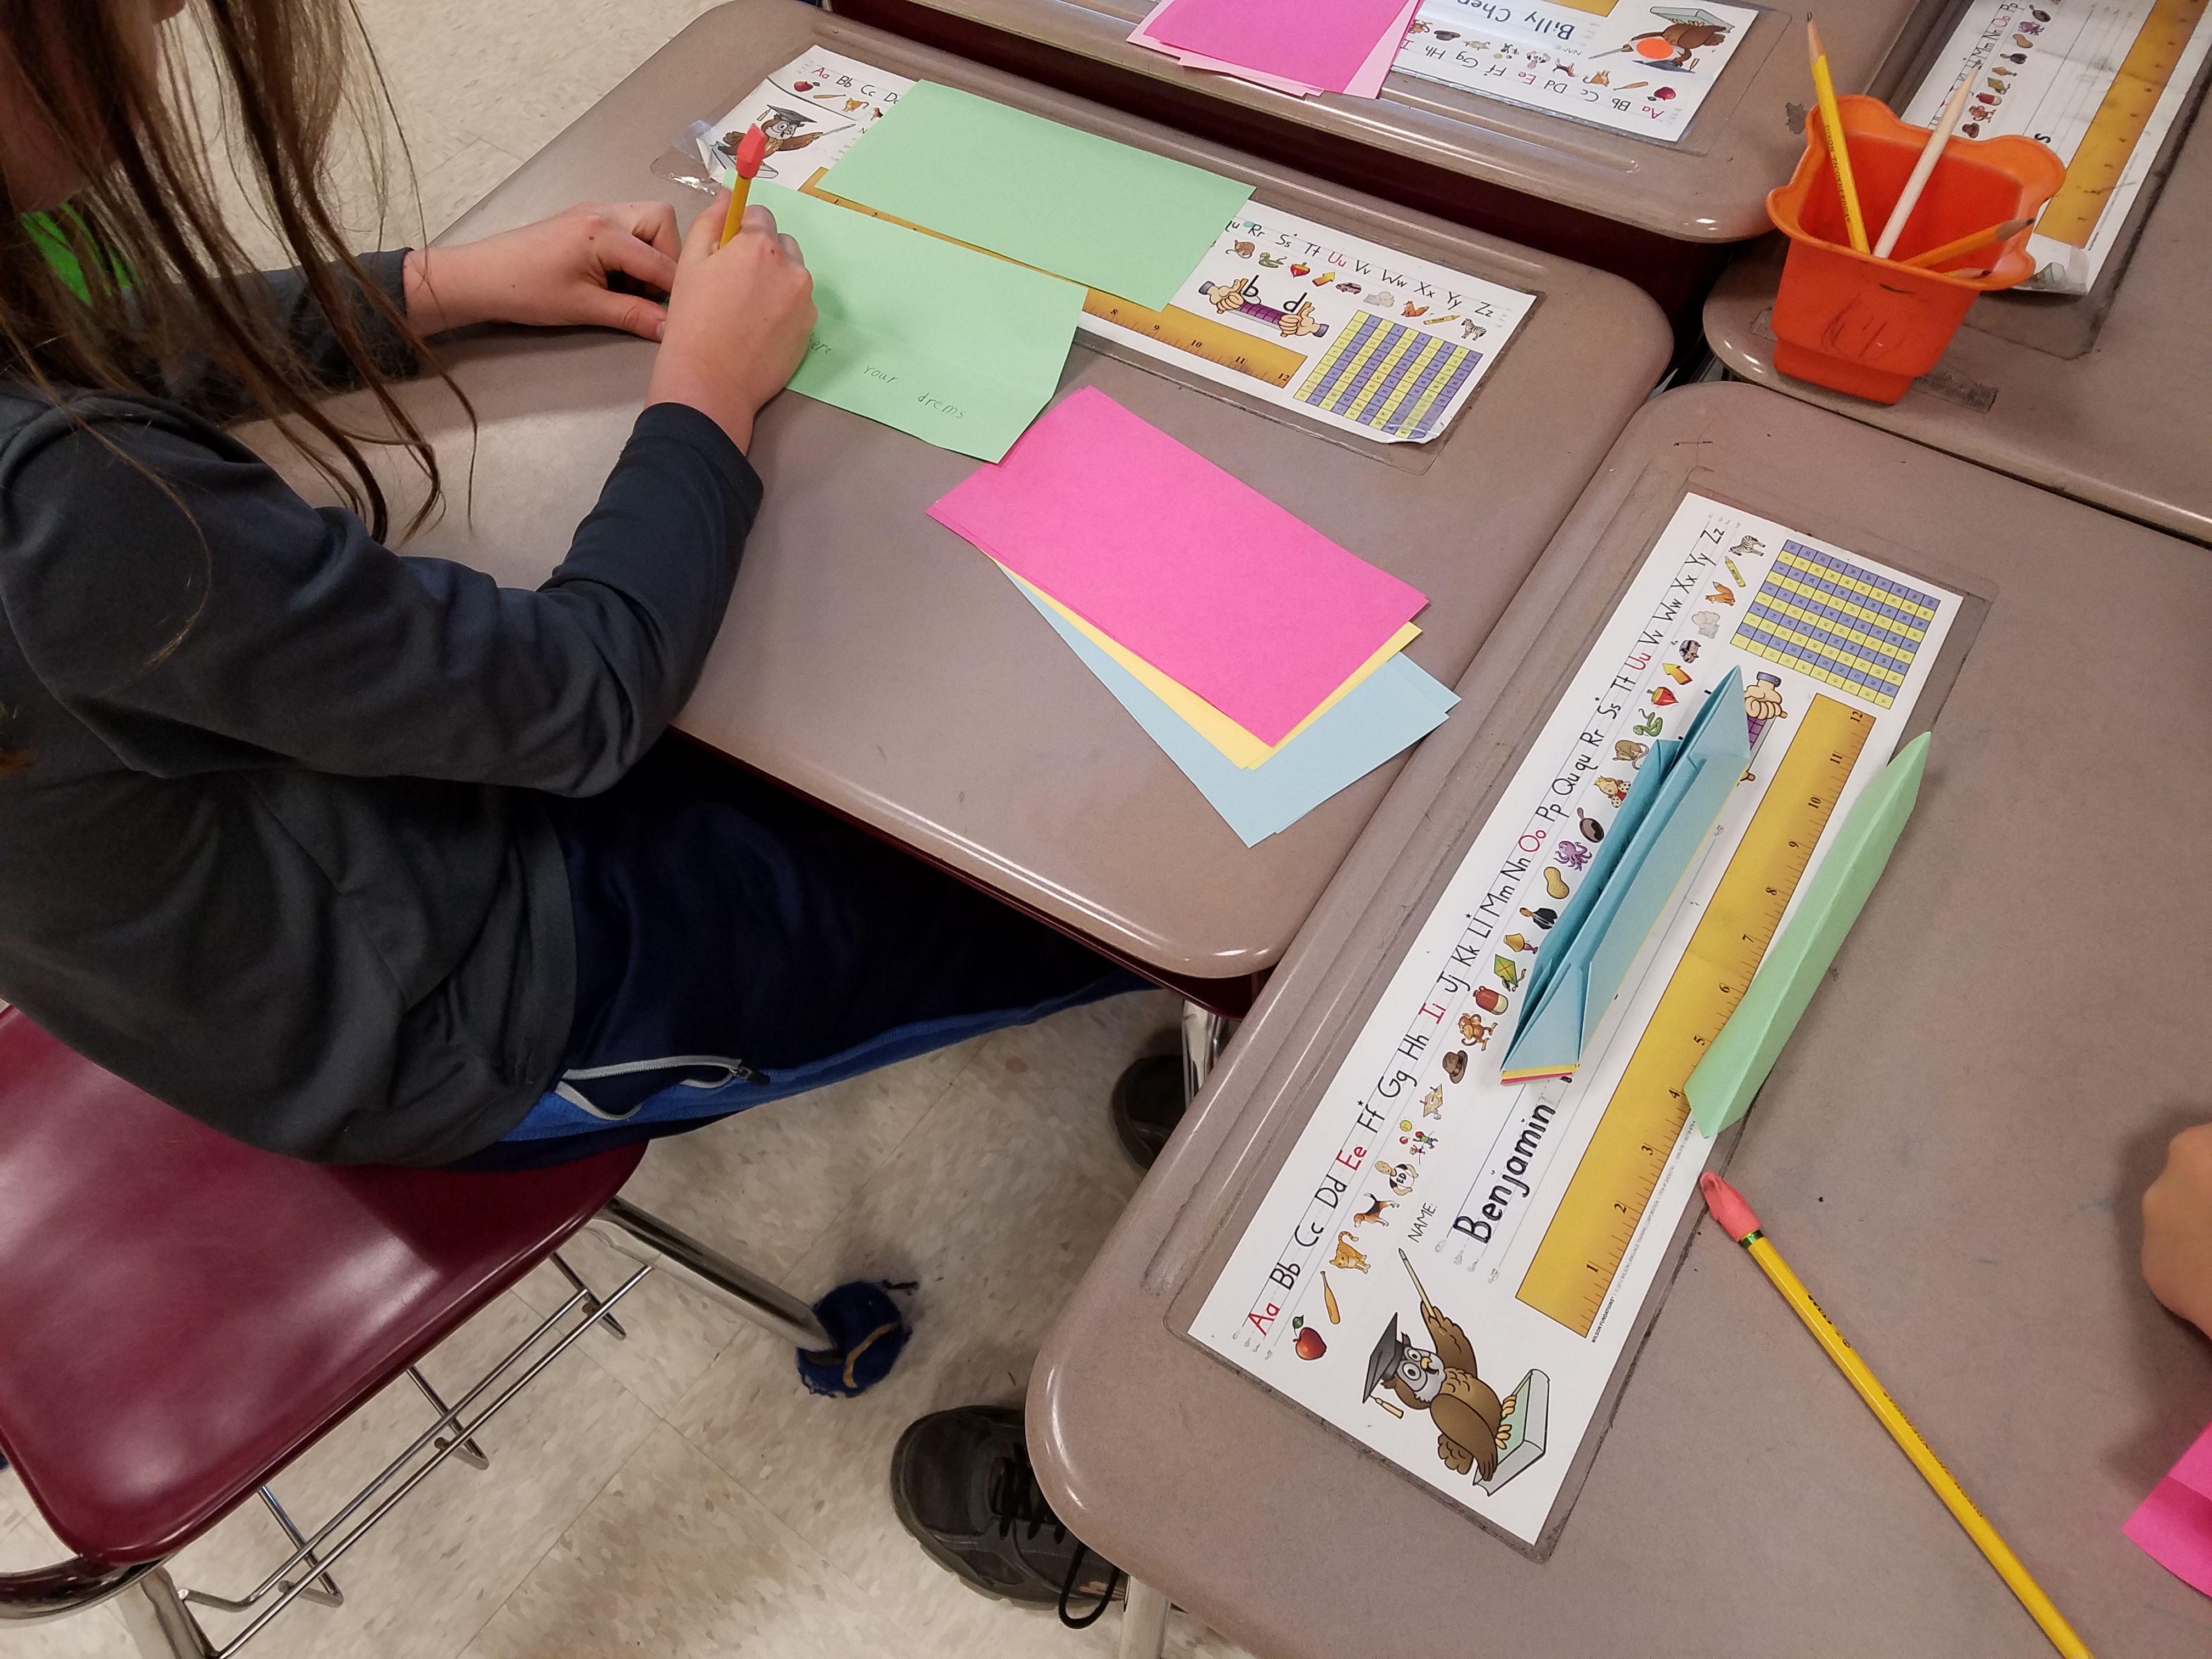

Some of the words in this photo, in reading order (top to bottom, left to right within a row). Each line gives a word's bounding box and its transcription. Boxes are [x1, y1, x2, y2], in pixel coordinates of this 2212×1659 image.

[1524, 11, 1576, 41] Billy
[1425, 46, 1447, 60] Hh
[1455, 50, 1479, 68] Gg
[811, 67, 830, 79] Aa
[836, 75, 852, 88] Bb
[861, 84, 876, 97] Cc
[1487, 64, 1507, 77] Ff
[1518, 71, 1537, 85] Ee
[1543, 80, 1568, 94] Dd
[1580, 88, 1600, 102] Cc
[1612, 98, 1631, 112] Bb
[1642, 105, 1665, 120] Aa
[1248, 223, 1265, 238] Rr
[1275, 234, 1292, 247] Ss
[1304, 242, 1321, 257] Tt
[1328, 251, 1347, 267] Uu
[1356, 259, 1371, 275] Vv
[1382, 269, 1408, 287] Ww
[1413, 281, 1436, 298] Xx
[1447, 291, 1462, 311] Yy
[1474, 302, 1494, 317] Zz
[1242, 274, 1260, 297] b
[1283, 292, 1308, 313] d
[1190, 339, 1203, 347] 10
[1235, 356, 1246, 364] 11
[1278, 373, 1290, 381] 12
[1700, 528, 1725, 544] Zz
[1685, 553, 1717, 566] Yy
[1670, 575, 1698, 594] Xx
[1652, 598, 1683, 621] Ww
[1638, 630, 1664, 645] Vv
[1624, 653, 1651, 670] Uu
[1610, 675, 1637, 692] Tt
[1597, 703, 1622, 720] Ss
[1579, 731, 1605, 748] Rr
[1535, 803, 1570, 822] Pp
[1518, 830, 1547, 852] Oo
[1500, 857, 1531, 881] Nn
[1480, 885, 1516, 918] Mm
[1467, 917, 1494, 939] Ll
[1451, 945, 1480, 967] Kk
[1436, 970, 1471, 993] Jj
[1587, 1263, 1599, 1274] 1
[1615, 1203, 1628, 1214] 2
[1641, 1145, 1654, 1156] 3
[1668, 1089, 1680, 1099] 4
[1694, 1035, 1706, 1046] 5
[1719, 984, 1731, 994] 6
[1743, 934, 1756, 943] 7
[1765, 887, 1778, 896] 8
[1788, 840, 1800, 850] 9
[1808, 796, 1822, 810] 10
[1830, 752, 1844, 765] 11
[1850, 711, 1864, 724] 12
[1418, 1002, 1447, 1025] Ii
[1397, 1034, 1430, 1061] Hh
[1378, 1070, 1418, 1098] Gg
[1357, 1104, 1385, 1133] Ff
[1336, 1146, 1367, 1171] Ee
[1396, 1172, 1407, 1184] ED
[1453, 1104, 1556, 1244] Benjamin
[1314, 1174, 1348, 1209] Dd
[1294, 1222, 1324, 1247] Cc
[1407, 1203, 1438, 1243] NAME:
[1269, 1262, 1301, 1290] Bb
[1590, 1325, 1602, 1344] WILSON
[1620, 1263, 1630, 1279] WILSON
[1626, 1243, 1640, 1264] LANGUAGE
[1636, 1225, 1648, 1244] TRAINING
[1644, 1199, 1660, 1226] CORPORATION
[1248, 1302, 1280, 1336] Aa
